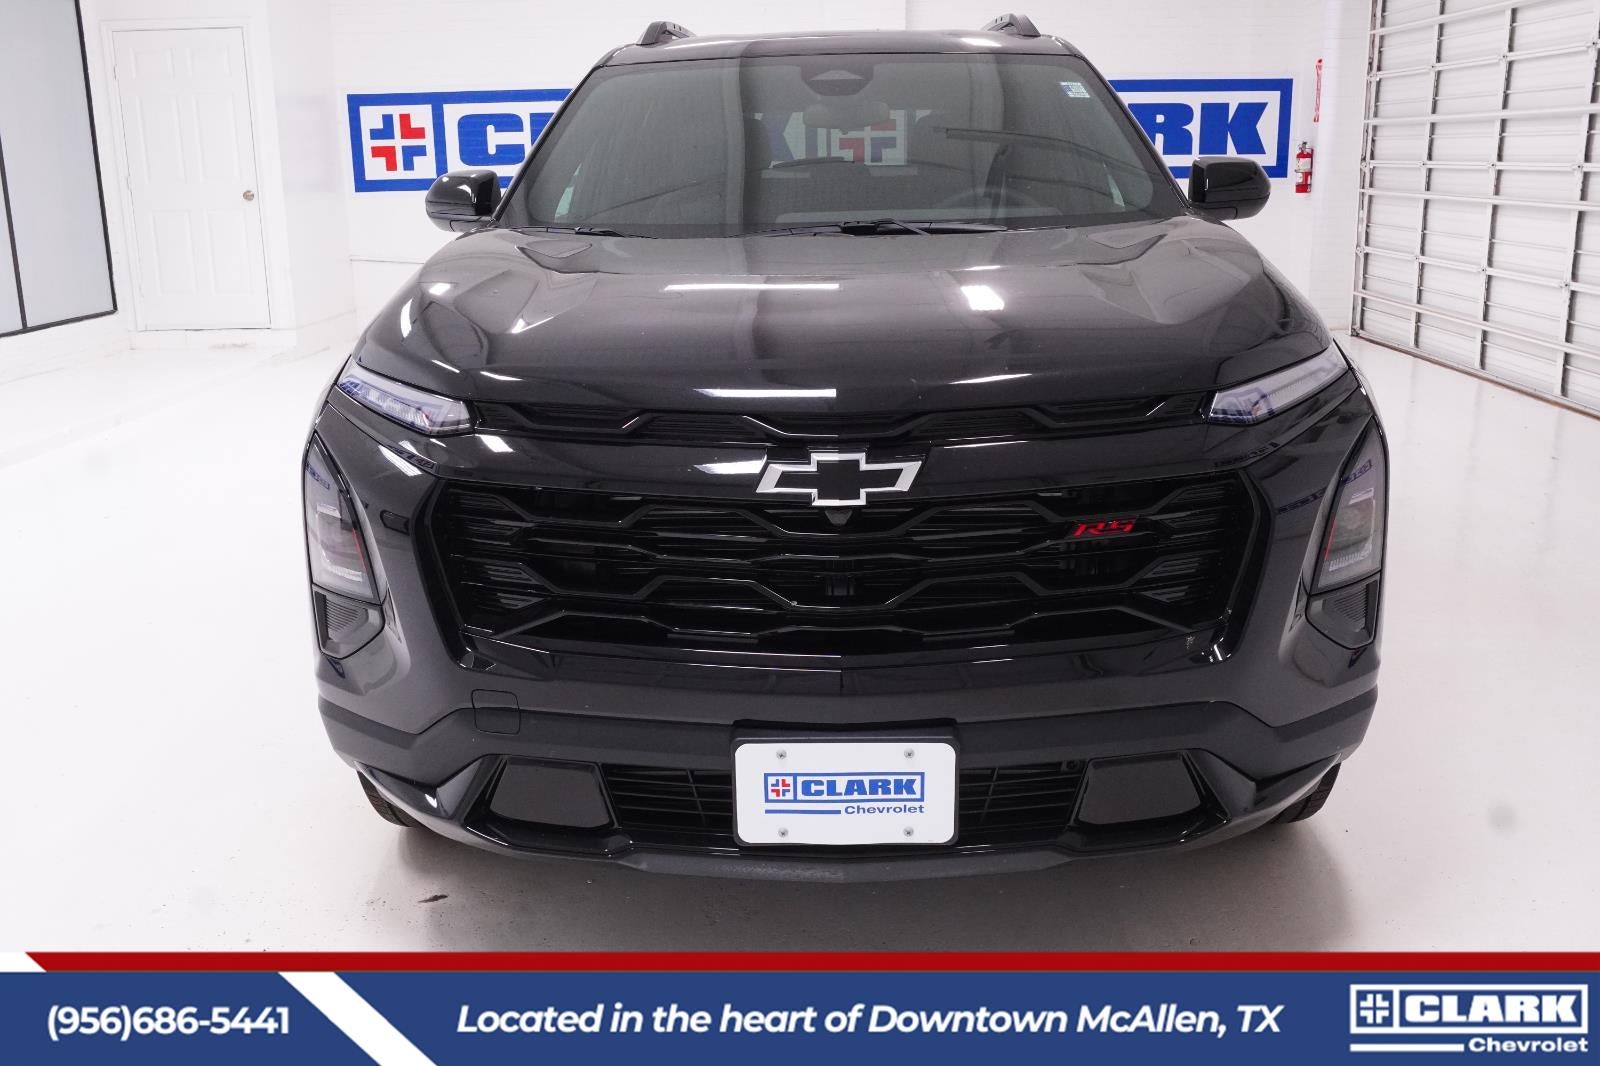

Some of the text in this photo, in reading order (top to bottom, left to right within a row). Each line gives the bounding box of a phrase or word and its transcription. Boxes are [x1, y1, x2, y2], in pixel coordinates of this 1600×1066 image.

[1072, 517, 1137, 538] RS
[800, 778, 917, 797] CLARK
[844, 804, 925, 815] Chevrolet
